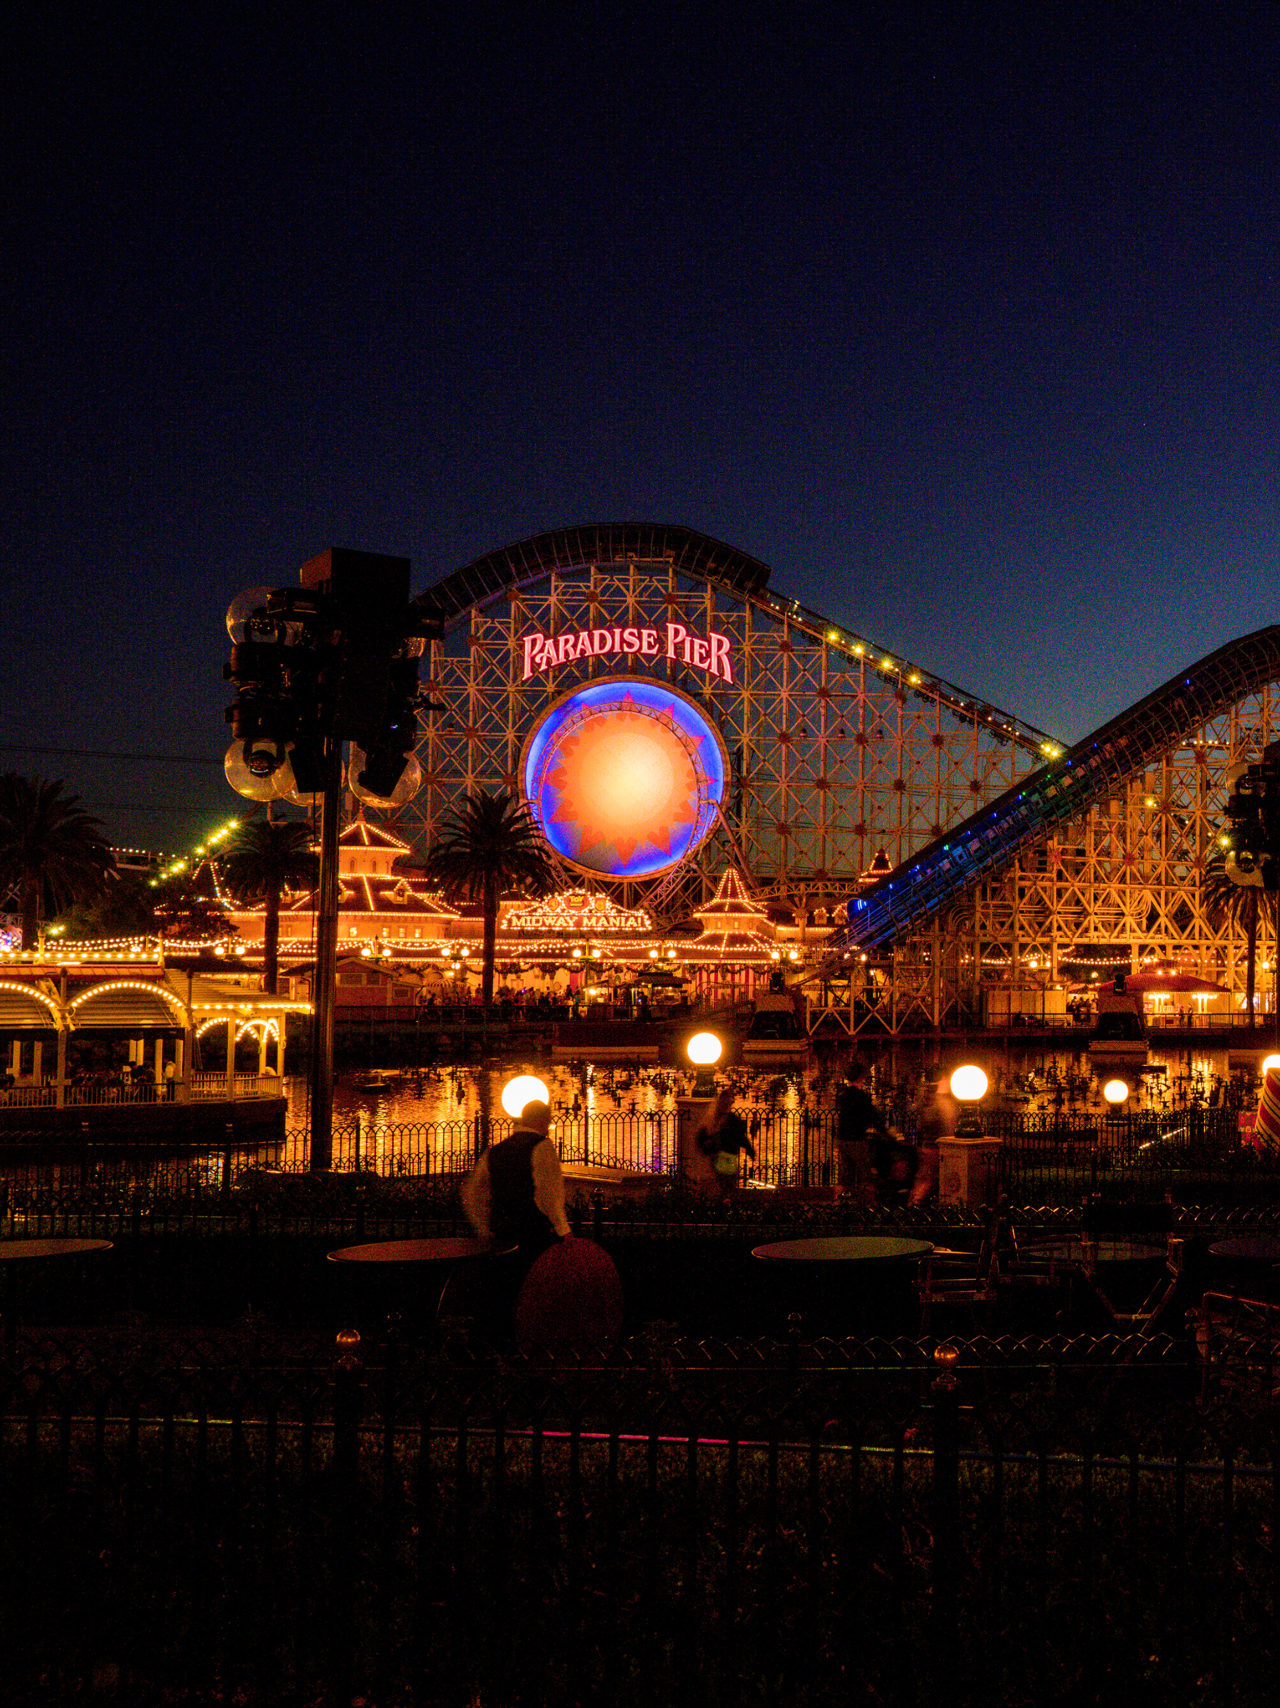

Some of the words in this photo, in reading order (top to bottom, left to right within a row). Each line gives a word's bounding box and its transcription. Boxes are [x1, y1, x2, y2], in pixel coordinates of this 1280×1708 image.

[522, 628, 659, 681] PARADISE
[666, 622, 734, 684] PIER
[511, 916, 578, 927] MIDWAY
[582, 916, 642, 927] MANIA!
